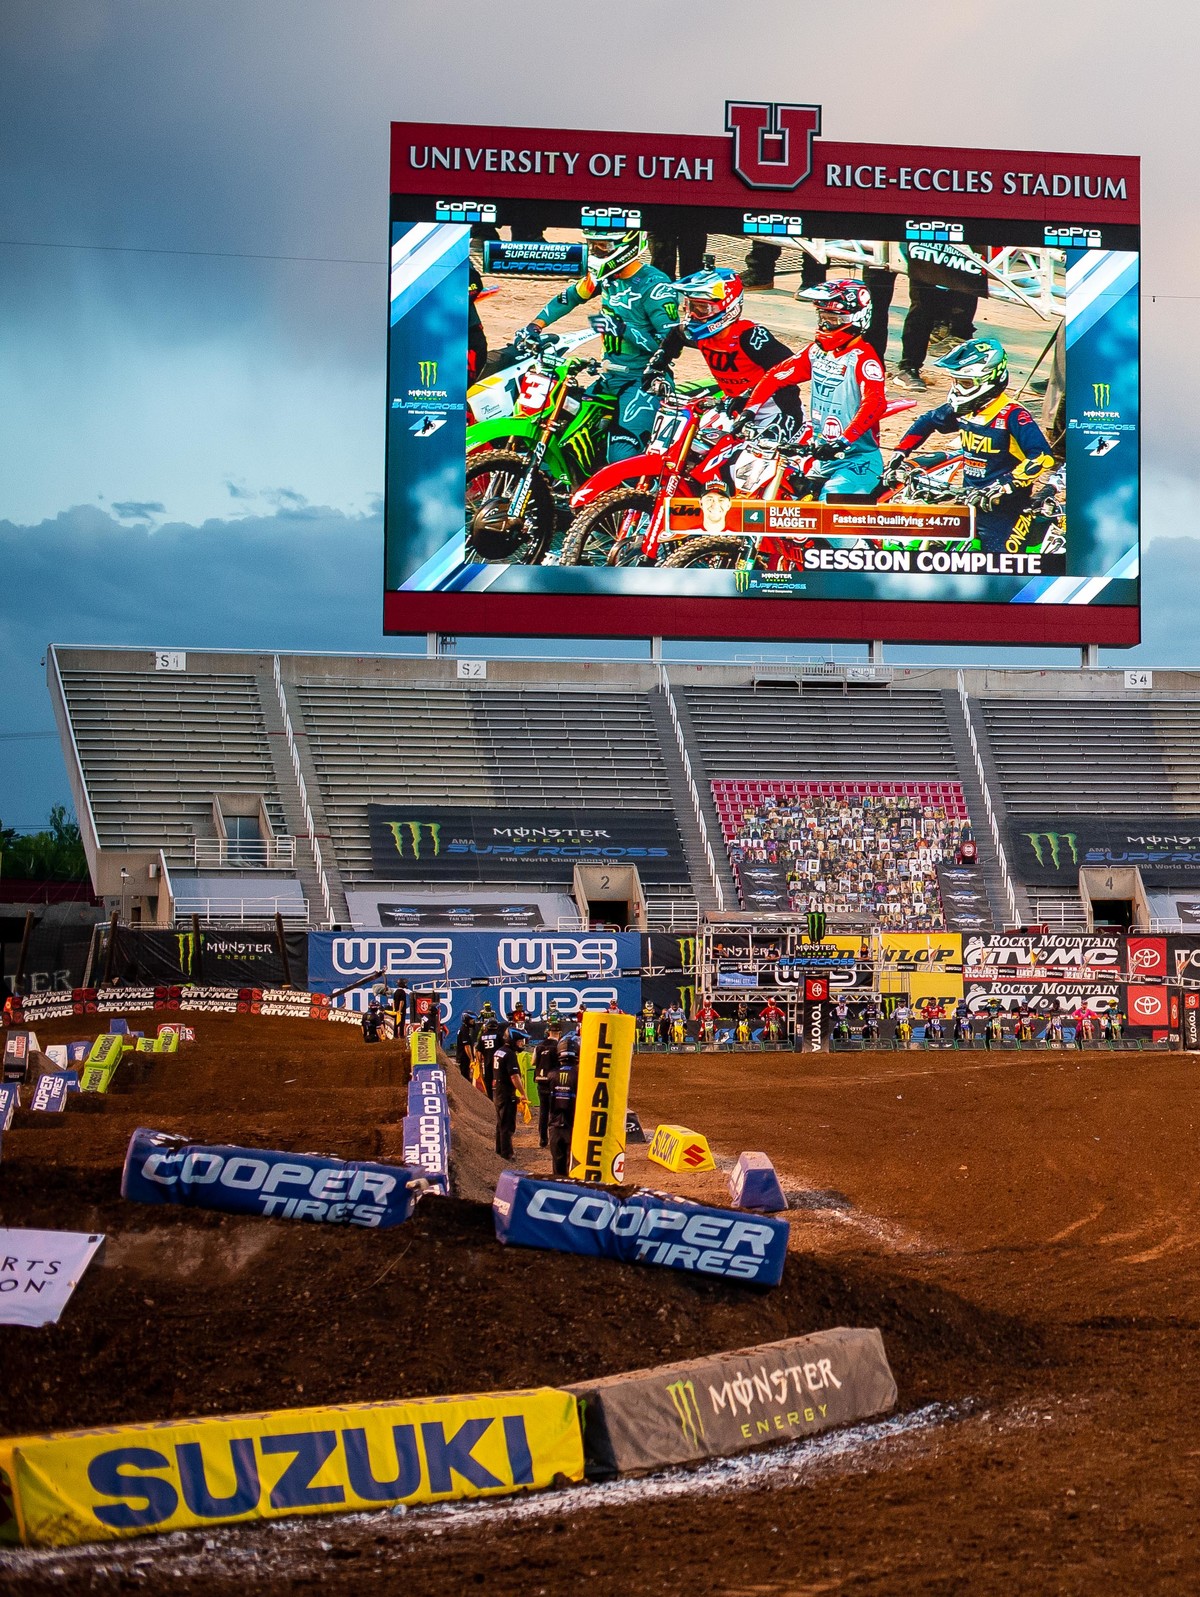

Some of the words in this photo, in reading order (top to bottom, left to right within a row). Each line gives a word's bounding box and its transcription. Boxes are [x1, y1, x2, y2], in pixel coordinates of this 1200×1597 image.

[409, 145, 579, 175] UNIVERSITY
[588, 153, 627, 178] OF
[638, 156, 715, 181] UTAH
[826, 164, 993, 194] RICE-ECCLES
[1003, 172, 1128, 200] STADIUM
[435, 201, 498, 213] GoPro
[581, 206, 642, 219] GoPro
[743, 212, 802, 225] GoPro
[905, 220, 964, 233] GoPro
[1044, 225, 1102, 239] GoPro
[504, 251, 567, 260] SUPERCROSS
[522, 372, 551, 410] 3
[749, 511, 759, 521] 4
[769, 506, 801, 517] BLAKE
[769, 517, 818, 528] BAGGETT
[832, 513, 865, 525] Fastest
[866, 515, 876, 525] in
[877, 515, 923, 528] Qualifying
[803, 549, 912, 572] SESSION
[916, 551, 1042, 574] COMPLETE
[493, 826, 611, 839] MONSTER
[445, 844, 671, 857] SUPERCROSS
[600, 875, 611, 890] 2
[1105, 877, 1114, 890] 4
[206, 940, 273, 954] MONSTER
[795, 942, 837, 951] MONSTER
[989, 934, 1038, 947] ROCKY
[1038, 934, 1118, 948] MOUNTAIN
[332, 938, 452, 975] WPS
[499, 938, 618, 975] WPS
[989, 982, 1038, 994] ROCKY
[1039, 982, 1119, 995] MOUNTAIN
[811, 1003, 821, 1053] TOYOTA
[1190, 1010, 1198, 1043] TOYOTA
[419, 1115, 441, 1173] COOPER
[141, 1153, 397, 1206] COOPER
[257, 1194, 388, 1229] TIRES
[526, 1188, 775, 1257] COOPER
[635, 1238, 765, 1279] TIRES
[706, 1356, 842, 1417] MONSTER
[740, 1403, 830, 1439] ENERGY
[86, 1414, 538, 1531] SUZUKI
